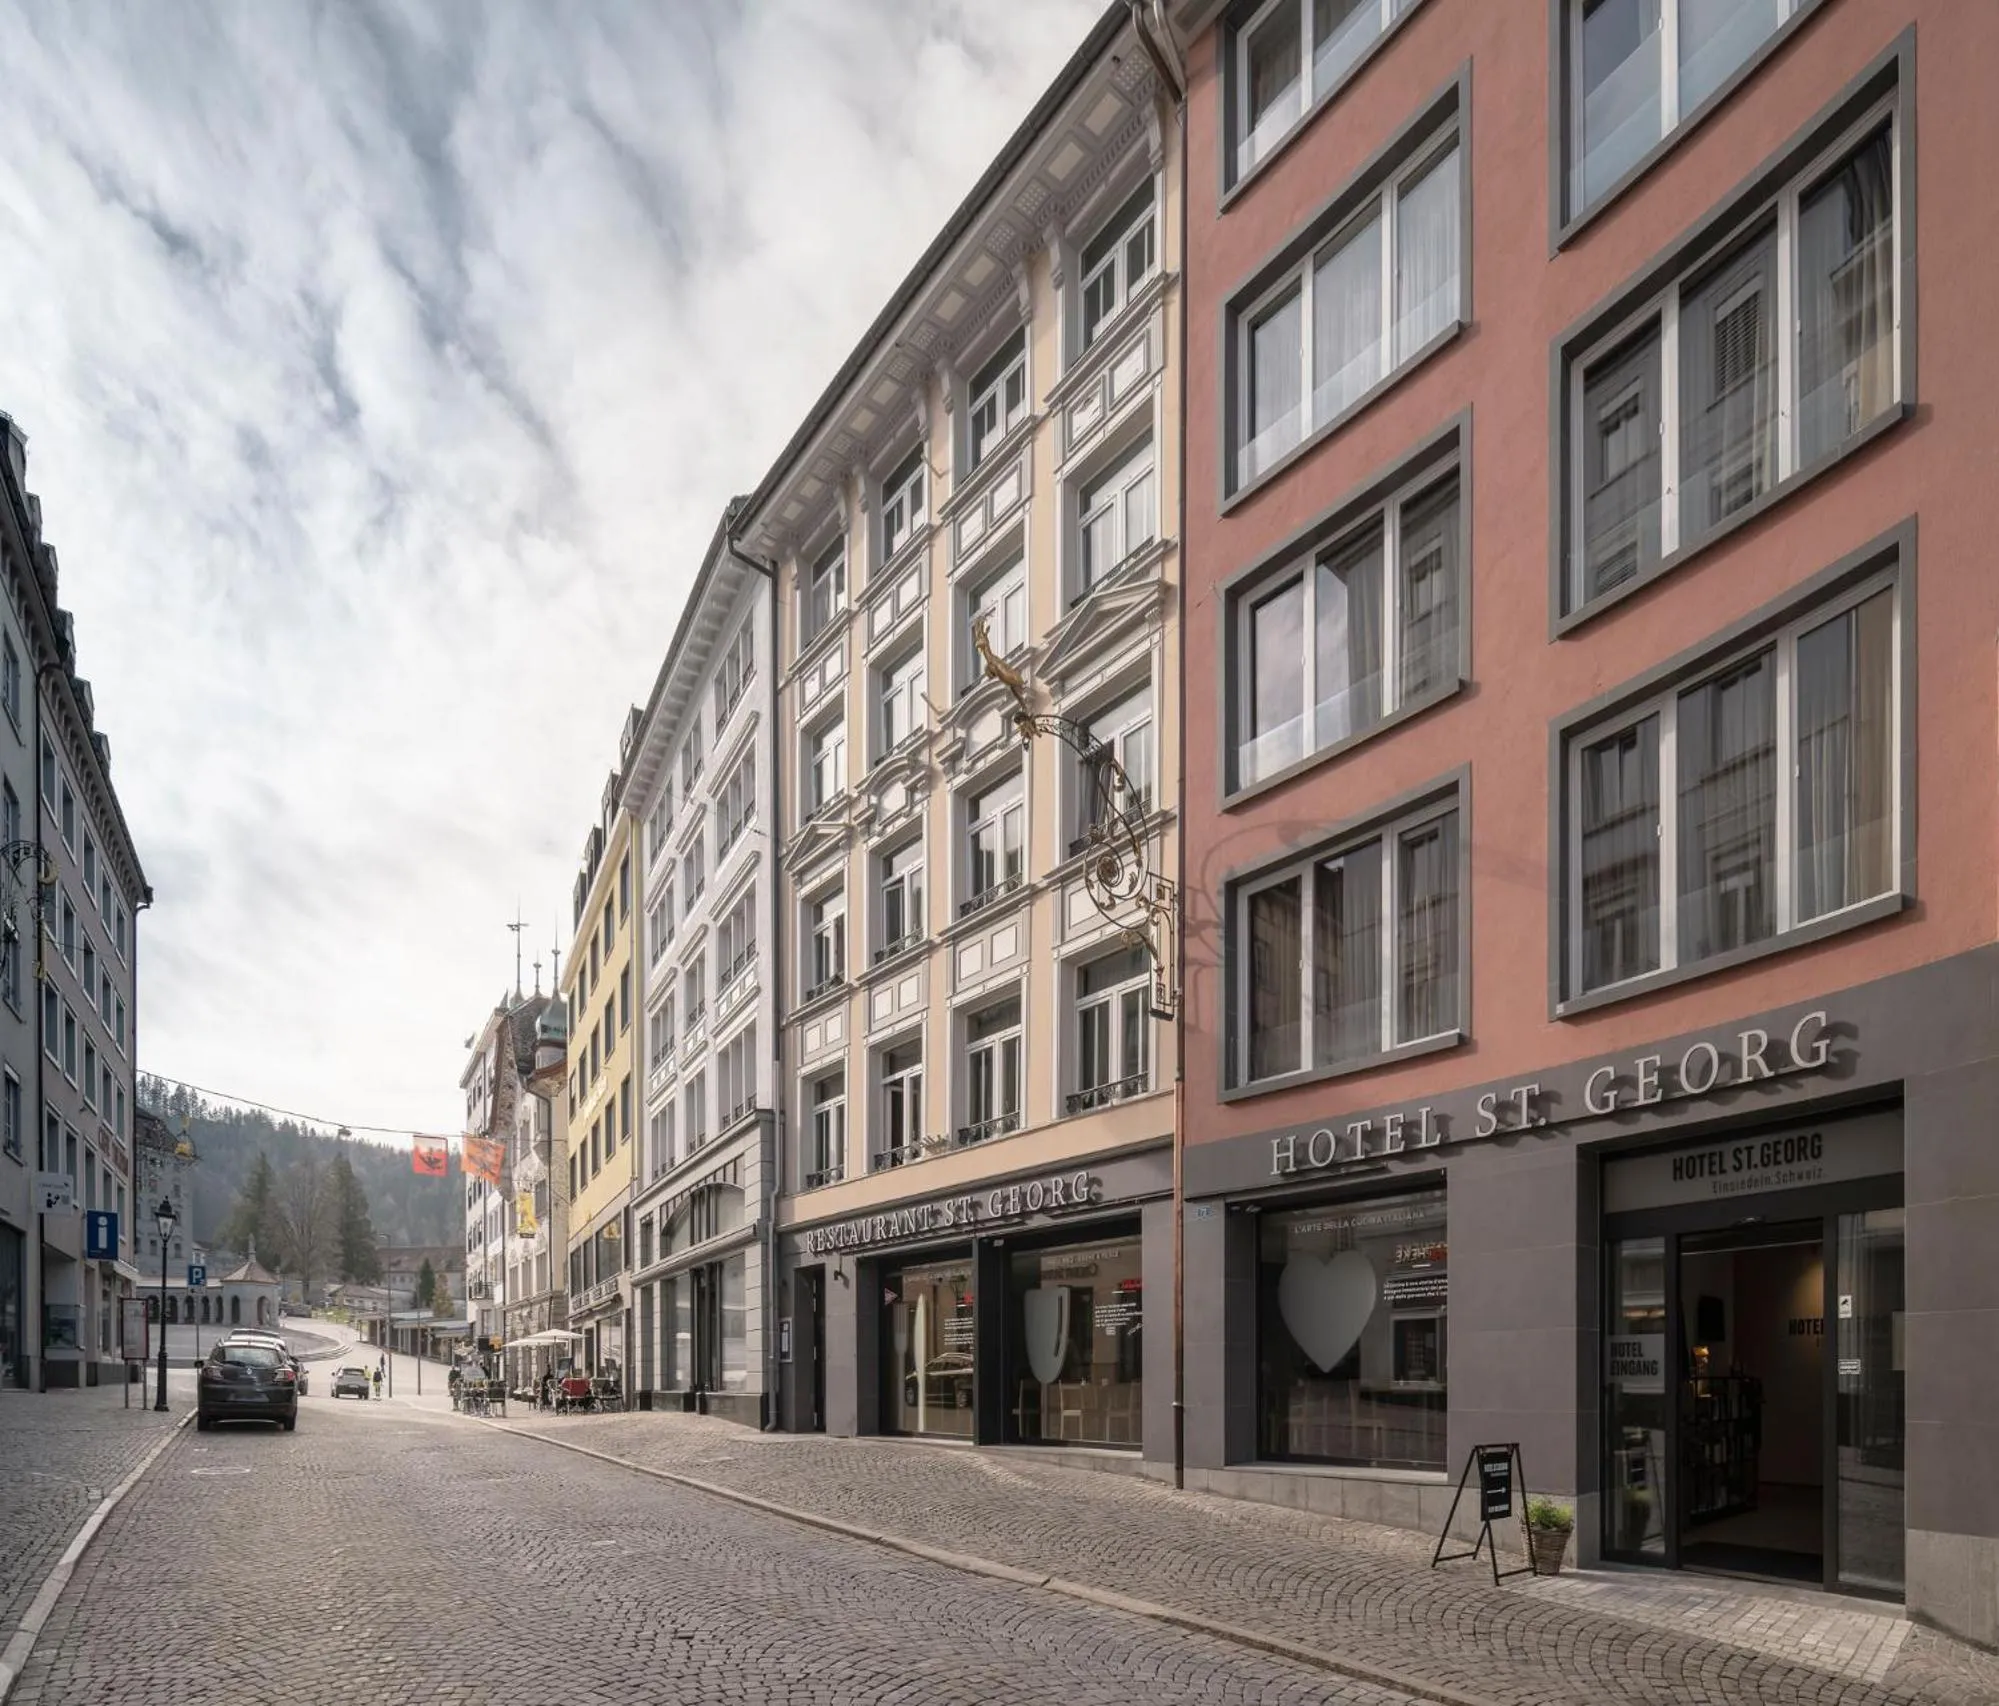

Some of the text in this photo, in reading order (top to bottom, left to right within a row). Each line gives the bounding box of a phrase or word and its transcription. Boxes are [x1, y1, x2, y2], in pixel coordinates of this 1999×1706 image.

[1270, 1010, 1831, 1175] HOTEL ST. GEORG
[1672, 1151, 1728, 1181] HOTEL
[805, 1171, 1090, 1252] RESTAURANT ST. GEORG
[192, 1267, 203, 1284] P
[1610, 1341, 1644, 1359] HOTEL
[1609, 1359, 1659, 1377] EINGANG
